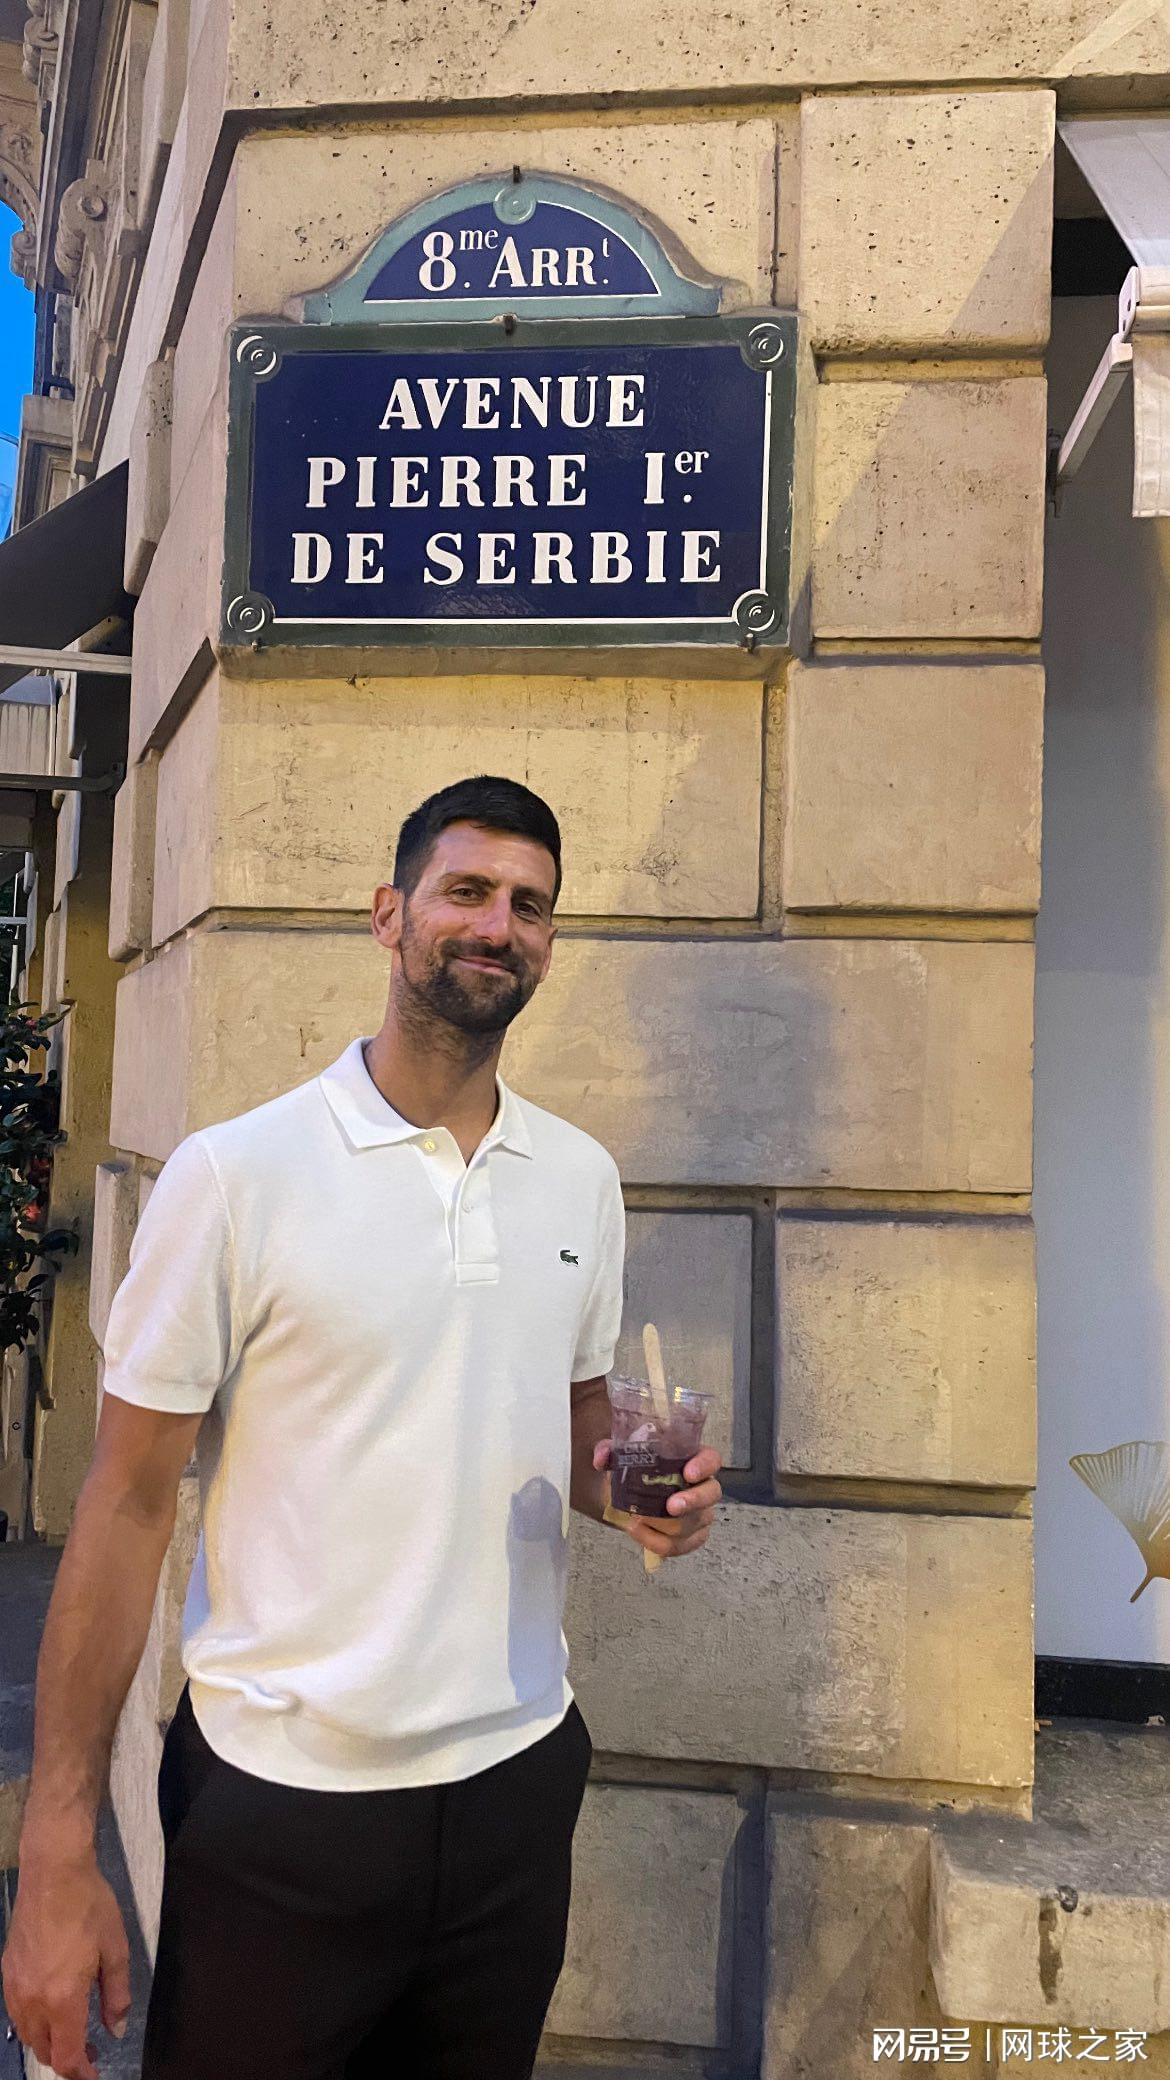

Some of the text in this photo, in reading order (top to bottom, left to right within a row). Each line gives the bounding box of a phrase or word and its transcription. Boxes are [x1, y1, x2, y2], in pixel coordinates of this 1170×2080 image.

[378, 374, 645, 430] AVENUE
[305, 454, 587, 508] PIERRE
[290, 530, 722, 586] DE SERBIE
